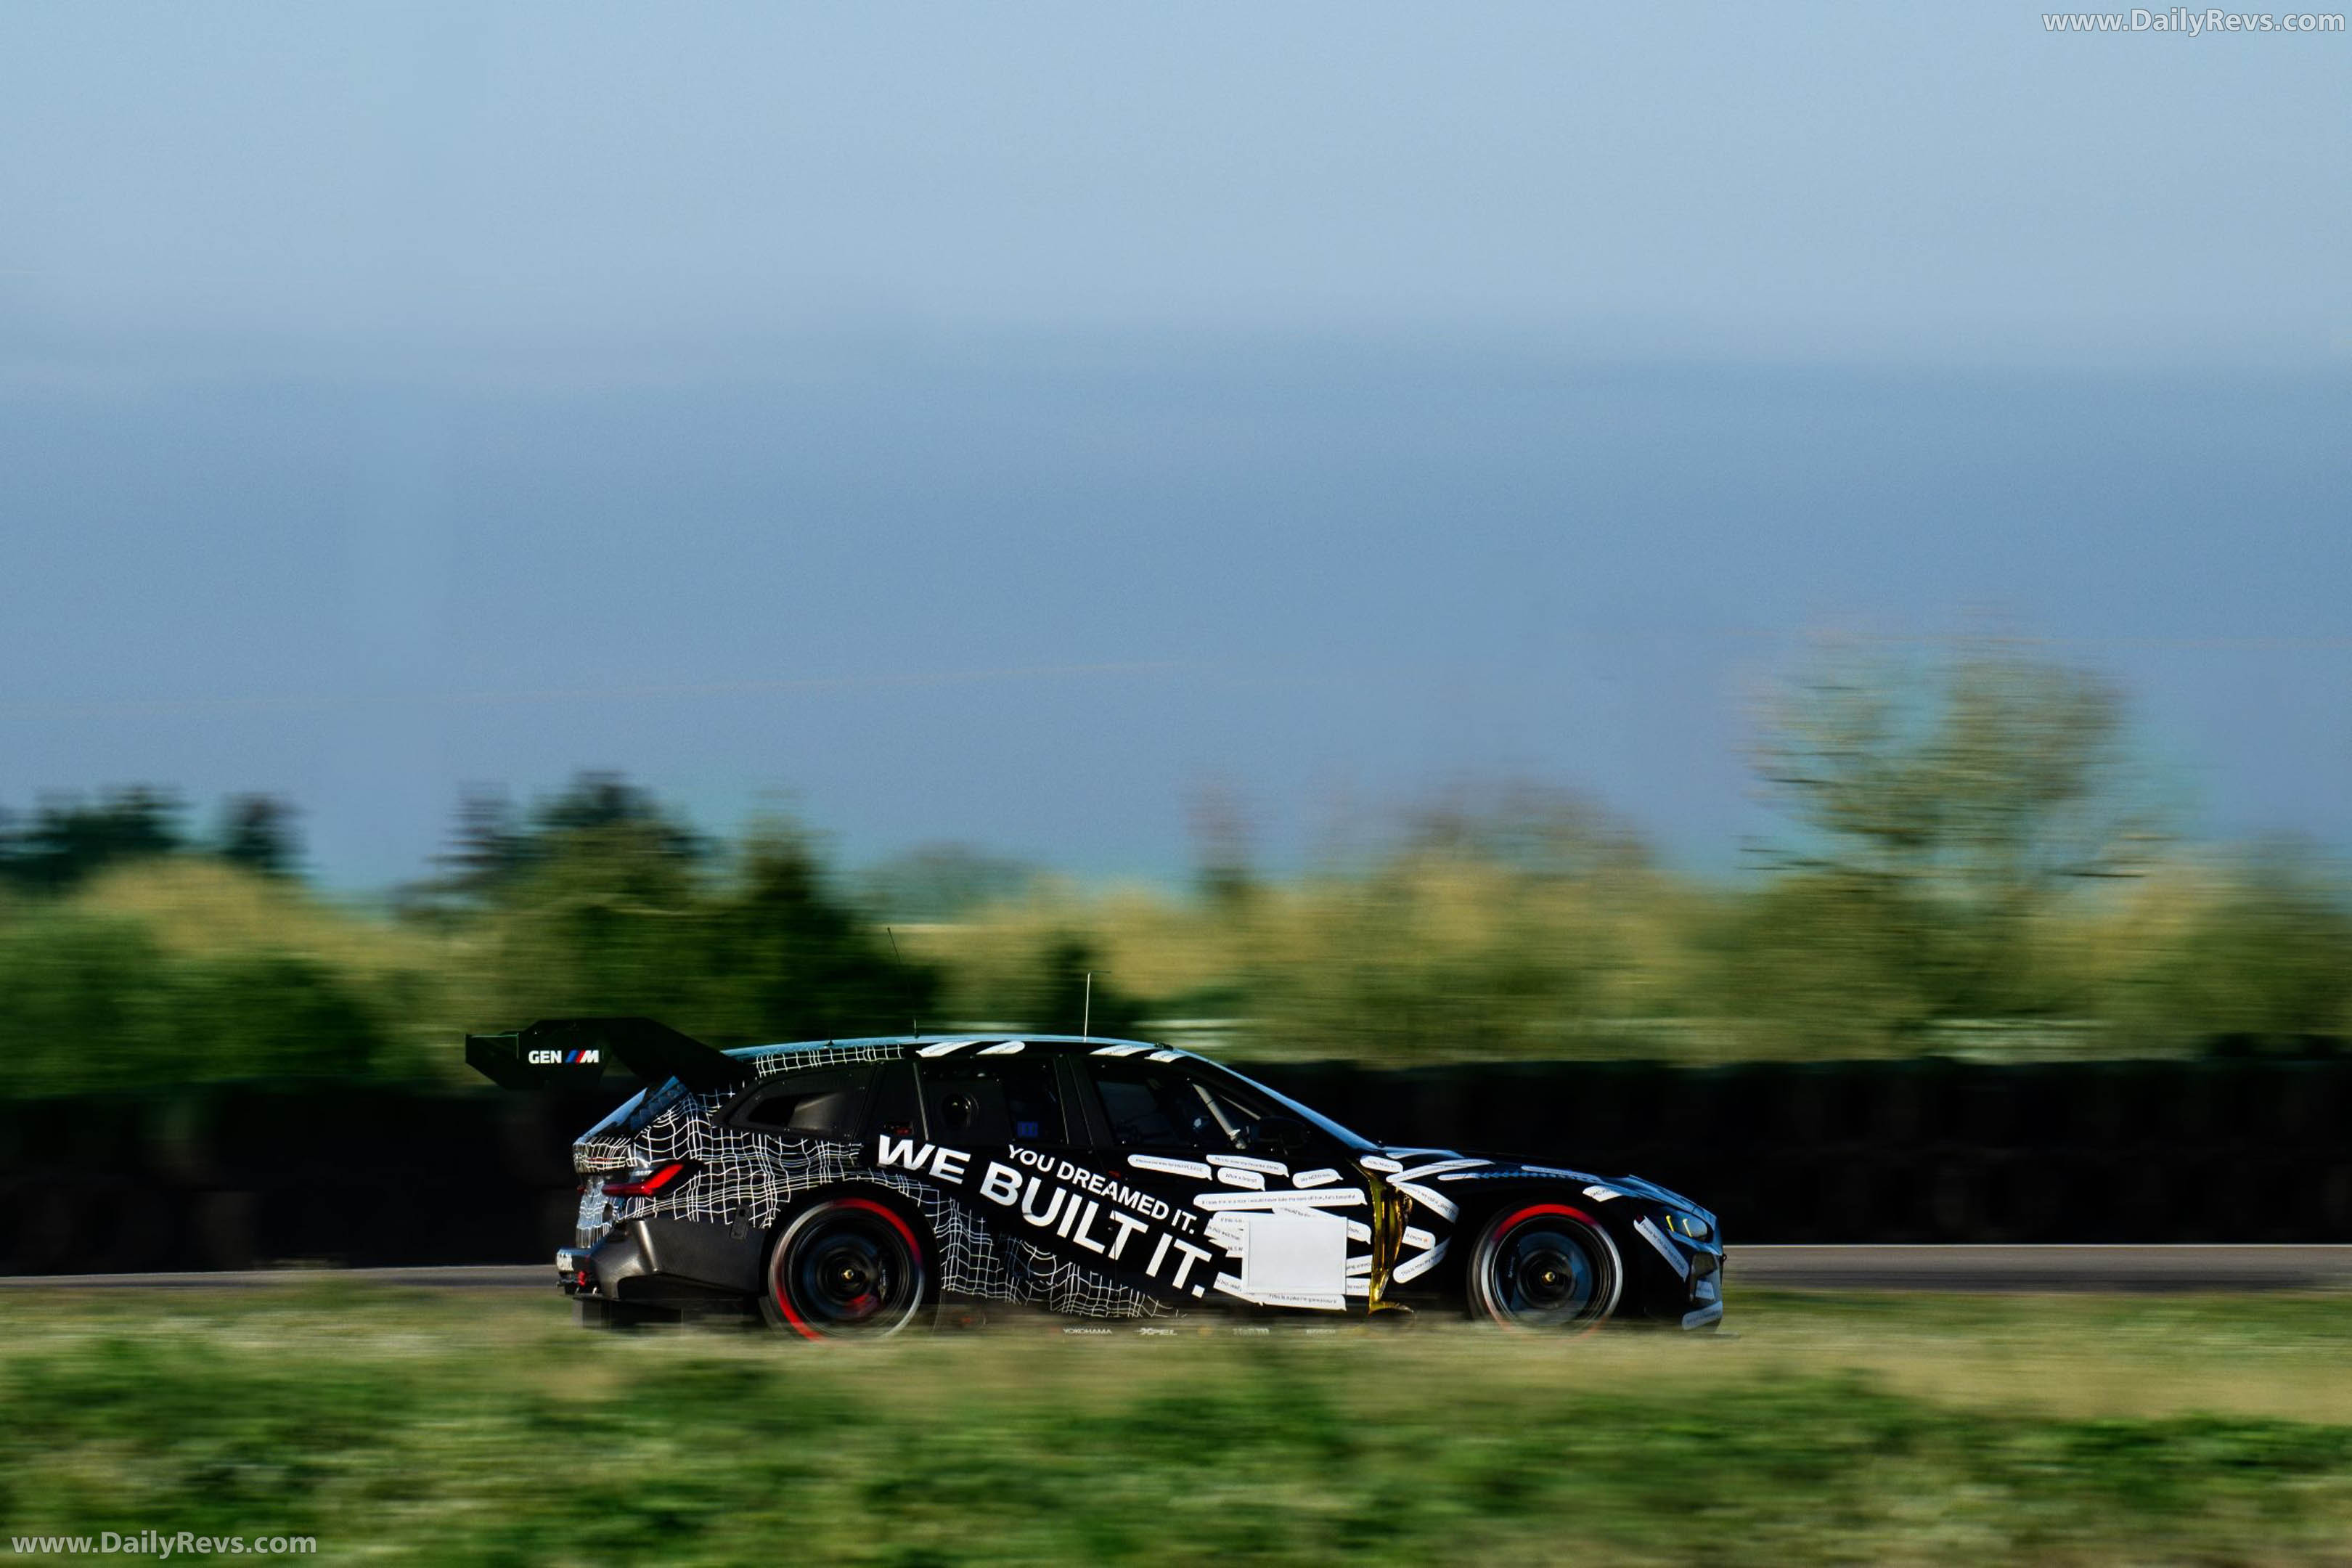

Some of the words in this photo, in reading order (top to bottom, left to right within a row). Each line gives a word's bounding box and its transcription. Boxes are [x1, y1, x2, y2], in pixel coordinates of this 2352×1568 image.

[528, 1050, 562, 1063] GEN
[878, 1135, 971, 1185] WE
[980, 1161, 1148, 1261] BUILT
[1146, 1233, 1212, 1299] IT.
[1008, 1144, 1055, 1172] YOU
[1057, 1163, 1169, 1220] DREAMED
[1172, 1209, 1198, 1235] IT.
